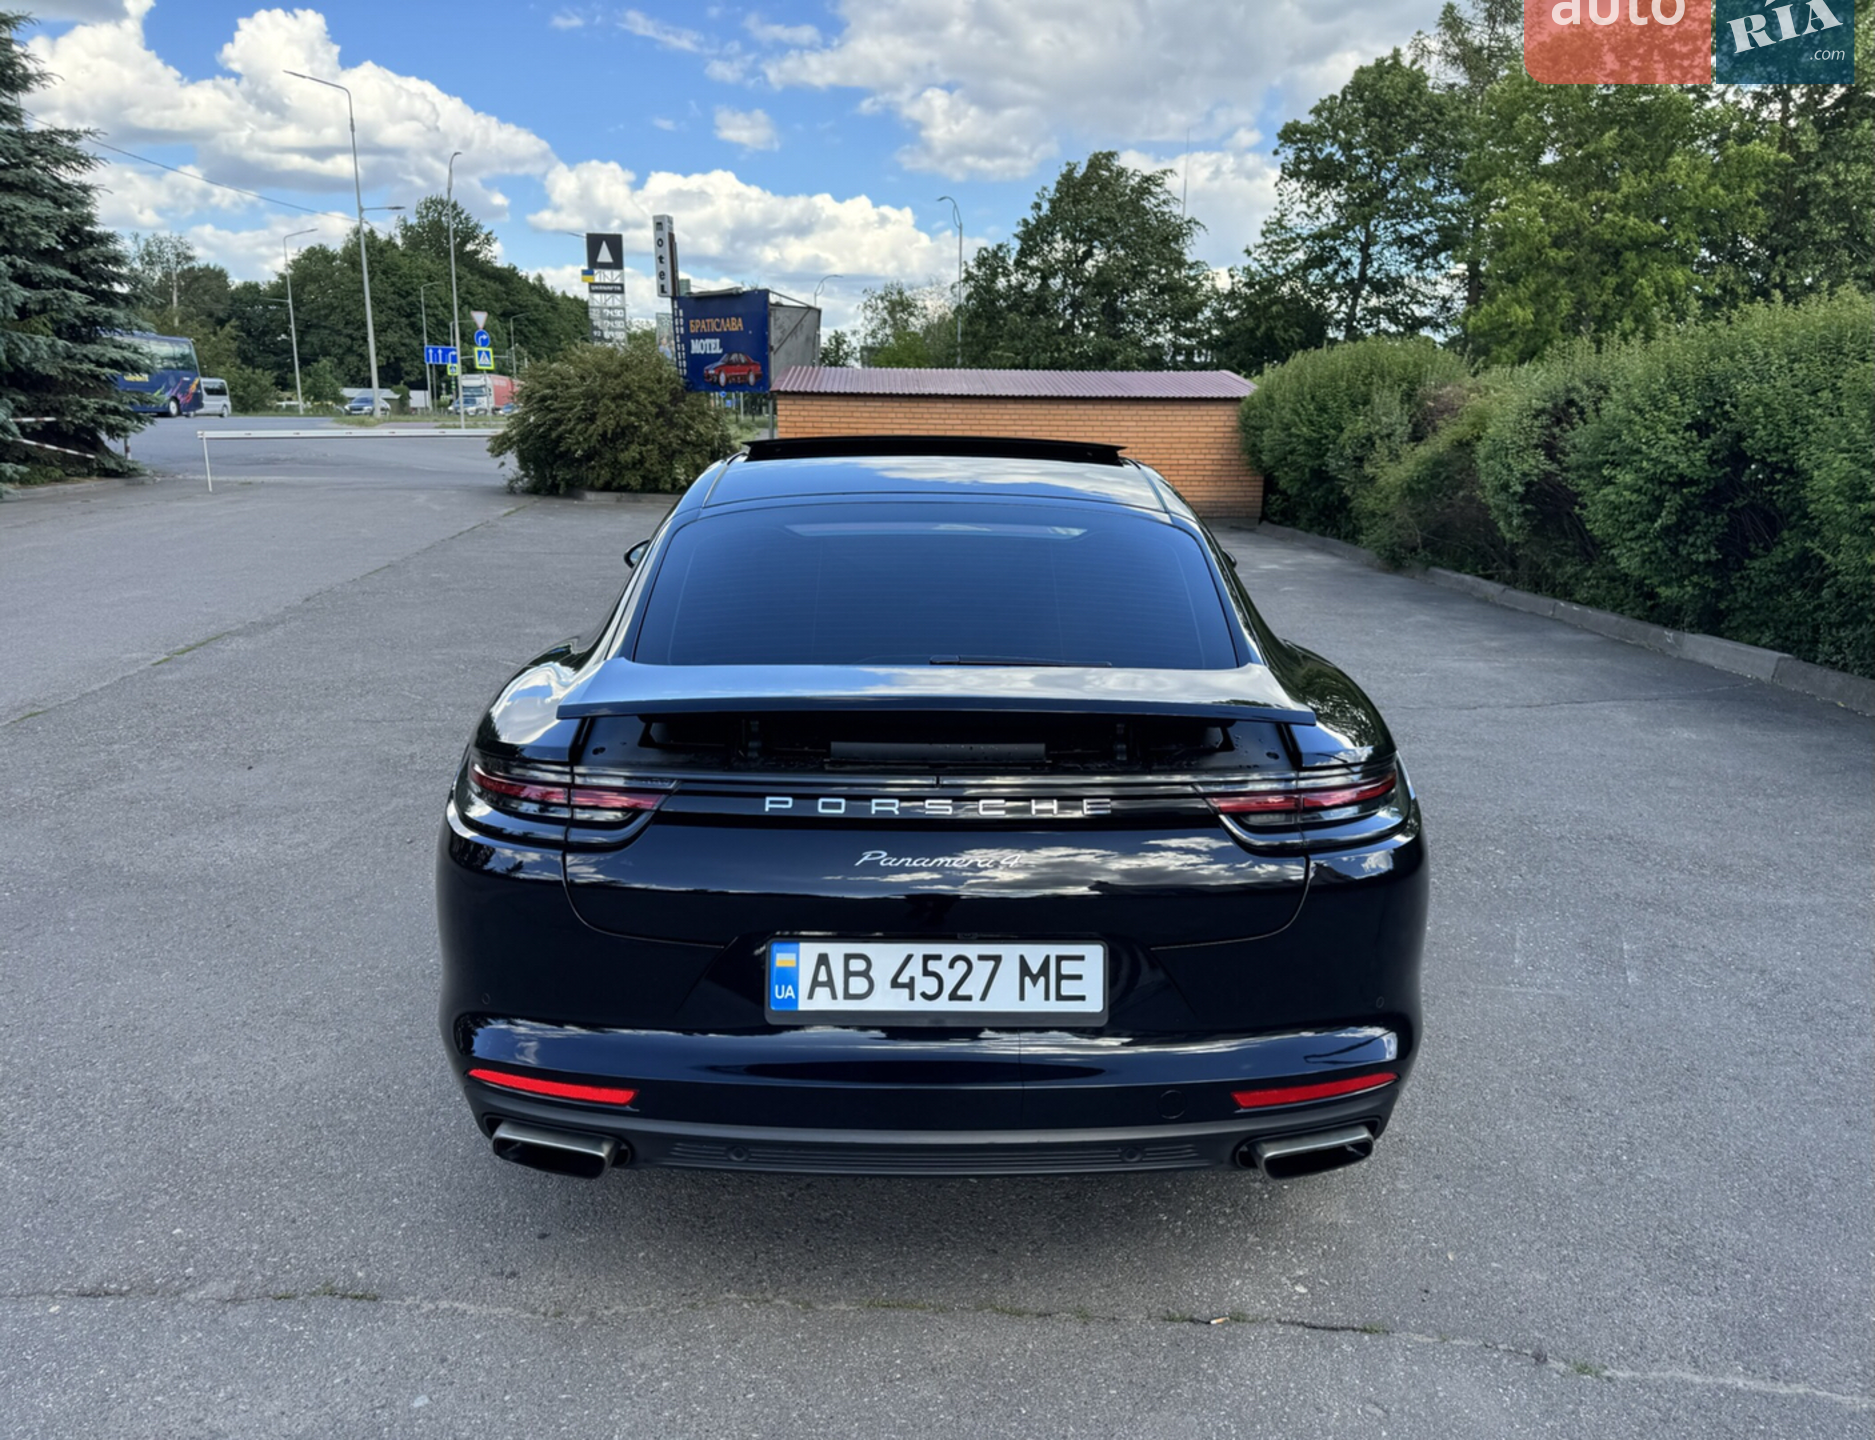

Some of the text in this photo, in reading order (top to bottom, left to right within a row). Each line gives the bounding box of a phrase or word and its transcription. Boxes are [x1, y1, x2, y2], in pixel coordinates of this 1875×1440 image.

[689, 317, 744, 333] БРАТІСЛАВА
[690, 338, 723, 354] MOTEL
[765, 796, 1112, 816] PORSCHE
[855, 850, 1021, 868] Panamera 4
[807, 953, 1087, 1002] AB 4527 ME
[775, 984, 796, 999] UA
